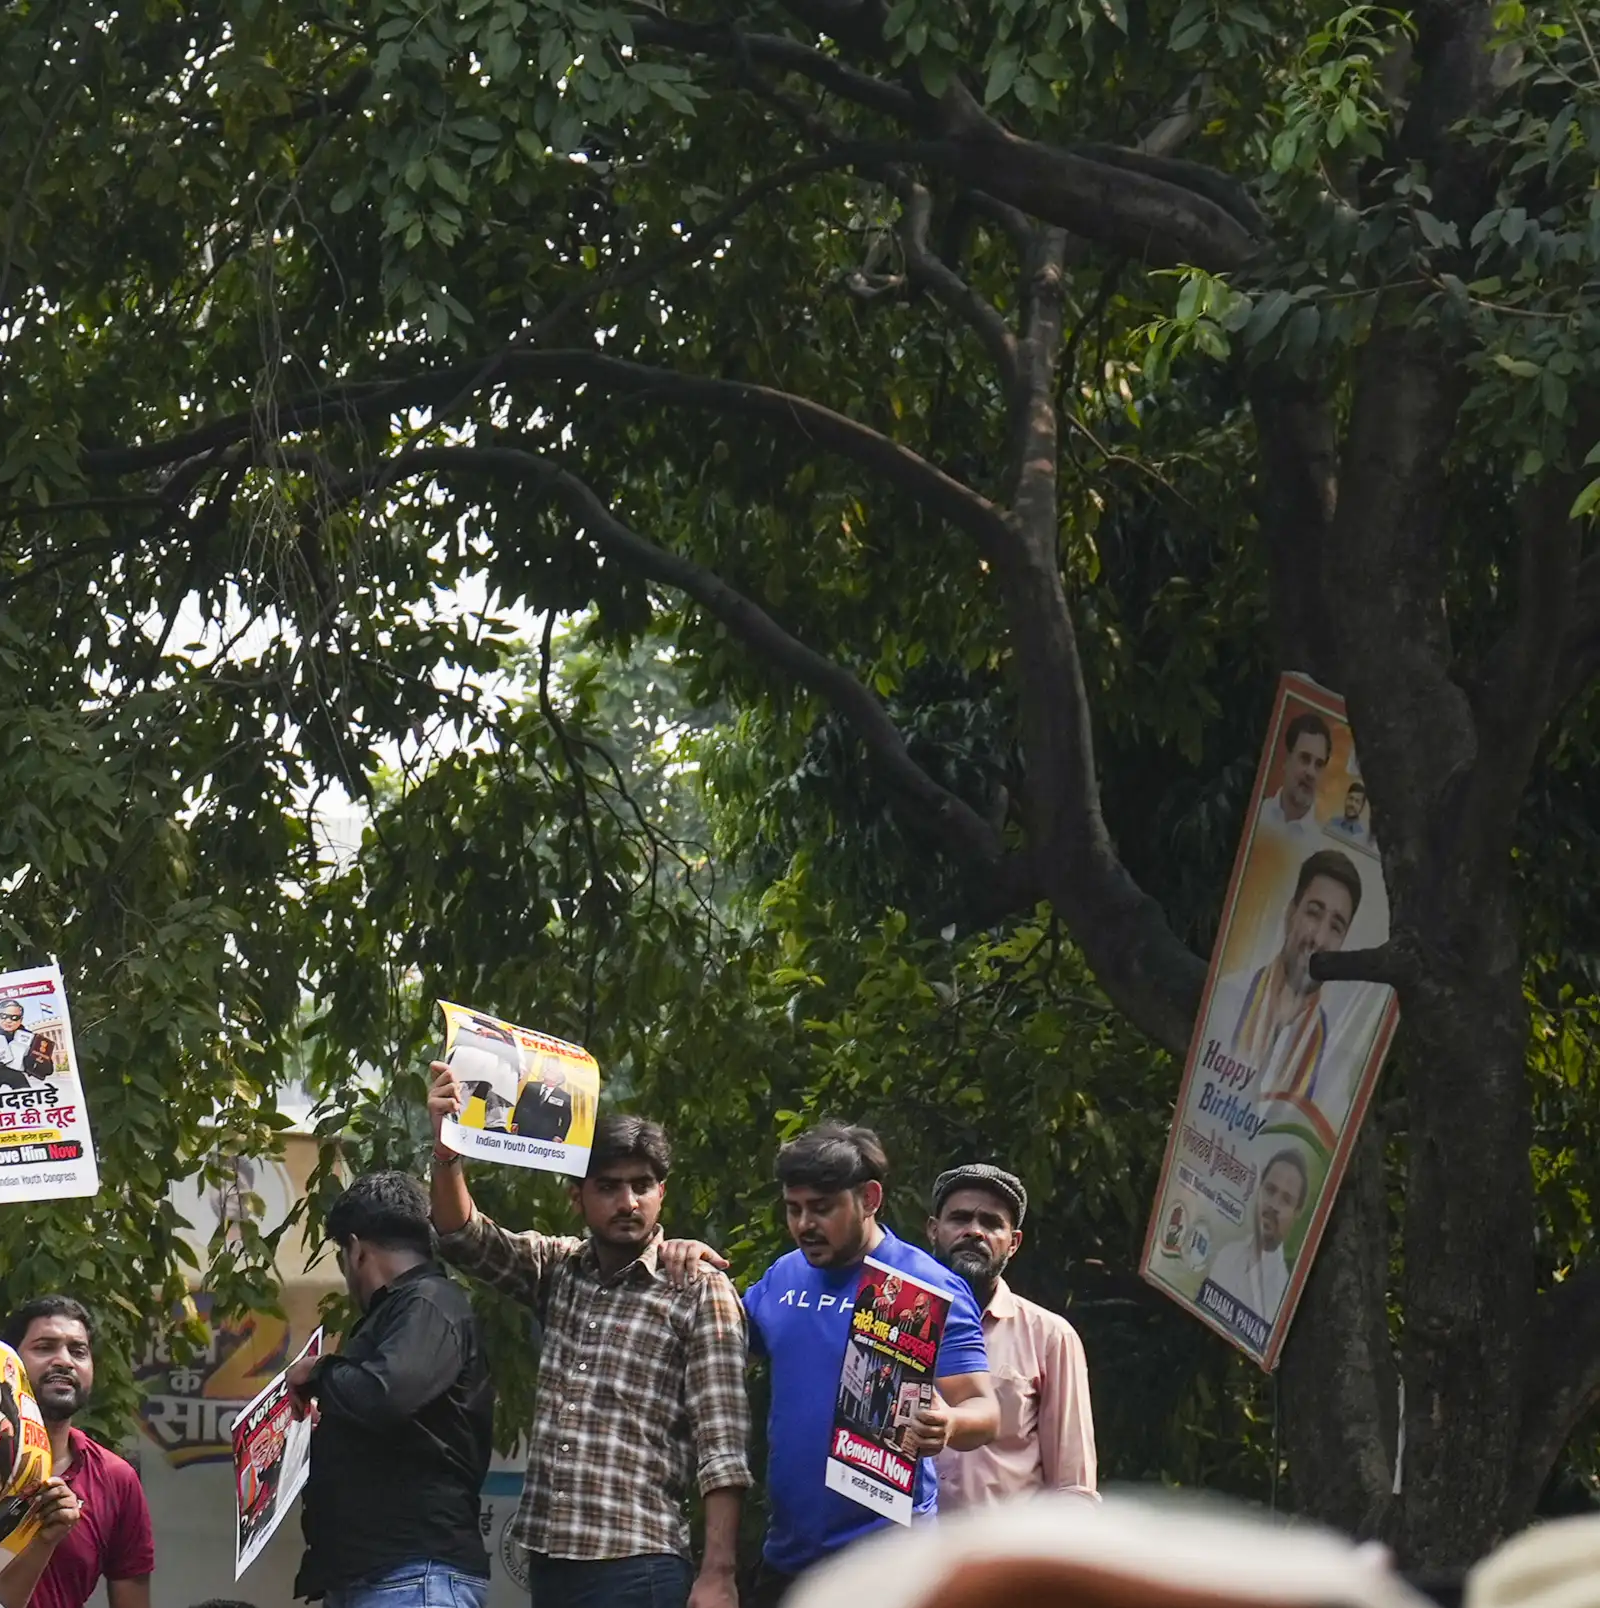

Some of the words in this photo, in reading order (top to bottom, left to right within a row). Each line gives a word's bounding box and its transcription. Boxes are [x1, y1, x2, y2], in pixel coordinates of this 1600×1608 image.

[1202, 1039, 1257, 1092] Happy
[21, 1108, 41, 1124] की
[45, 1105, 76, 1129] लूट
[1198, 1082, 1268, 1141] Birthday
[20, 1145, 47, 1162] Him
[48, 1144, 77, 1159] Now
[476, 1134, 501, 1148] Indian
[503, 1139, 526, 1152] Youth
[527, 1143, 565, 1160] Congress
[21, 1173, 42, 1185] Youth
[43, 1171, 77, 1184] Congress
[248, 1380, 288, 1429] VOTE-C
[834, 1429, 882, 1470] Removal
[883, 1452, 911, 1488] Now
